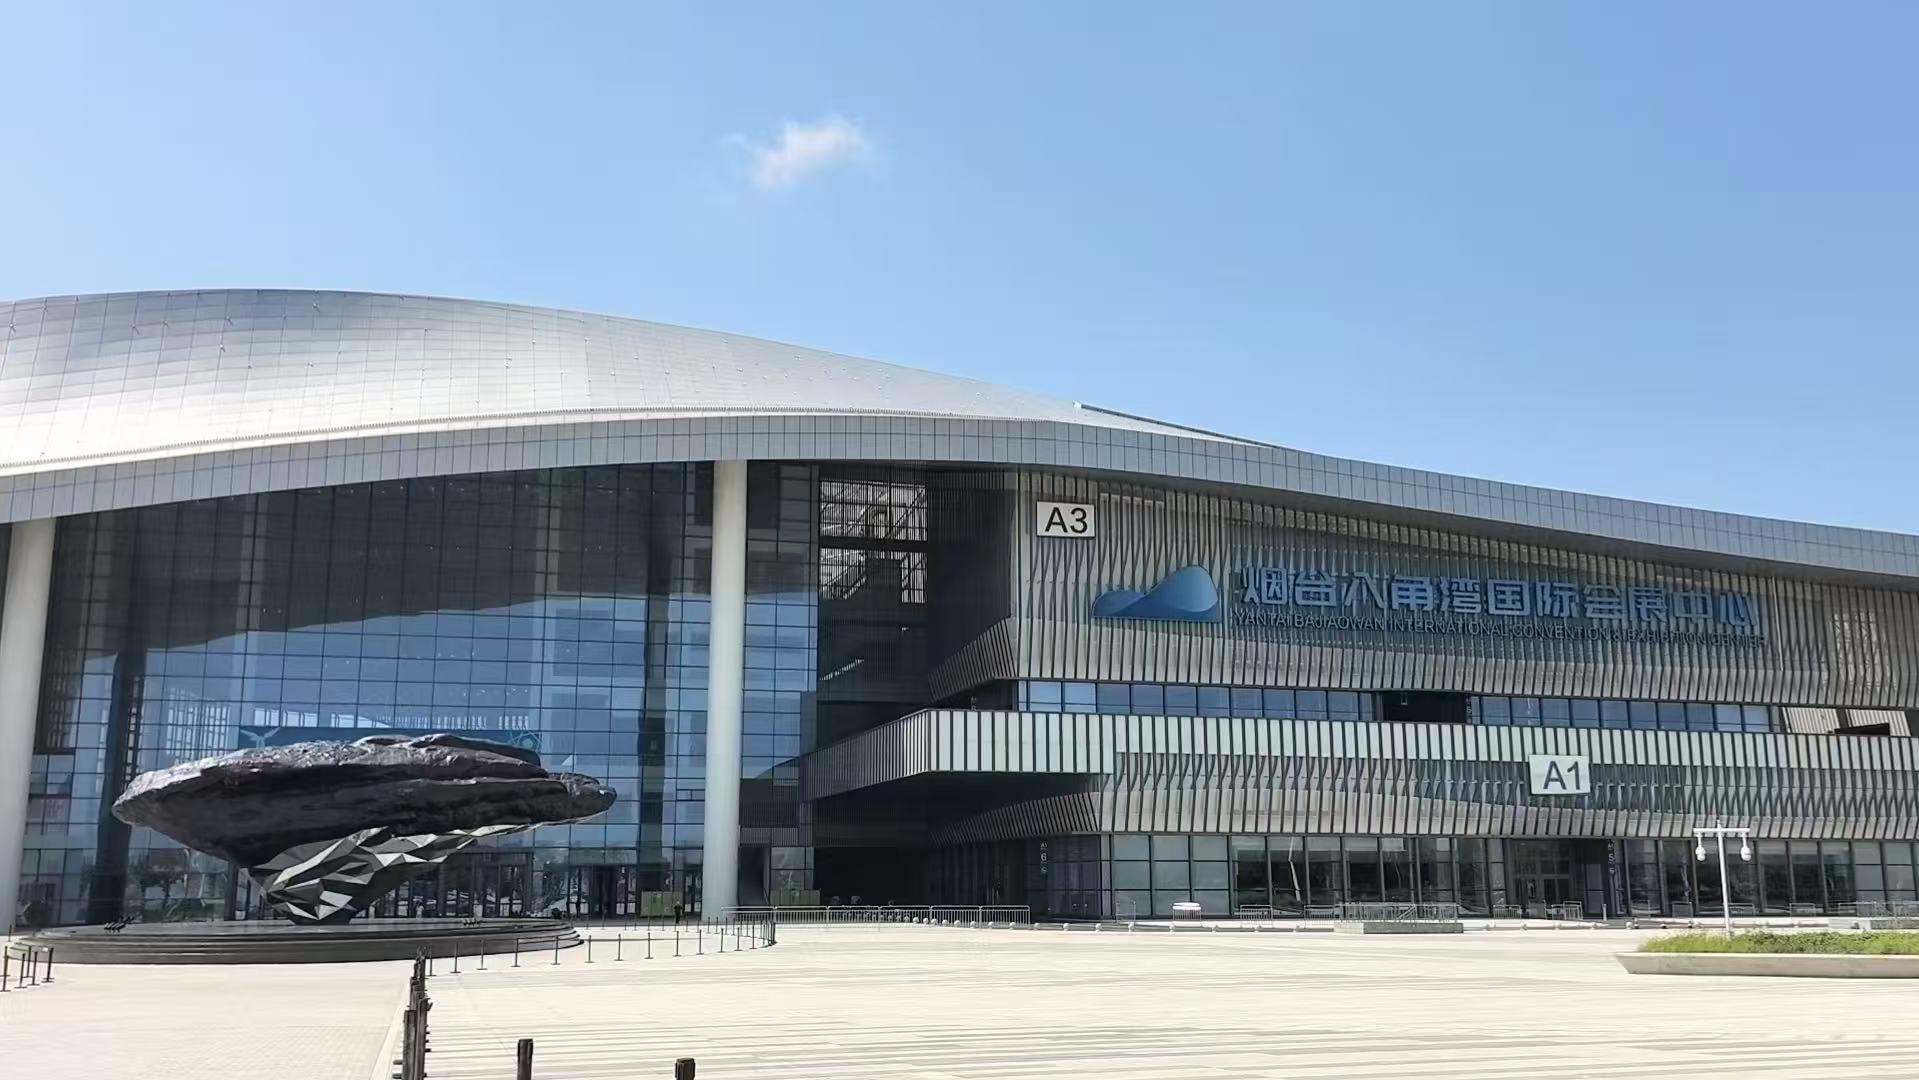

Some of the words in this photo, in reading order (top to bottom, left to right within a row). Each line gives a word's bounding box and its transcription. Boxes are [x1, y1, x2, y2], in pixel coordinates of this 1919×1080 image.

[1044, 506, 1089, 534] A3
[1241, 566, 1759, 628] 烟台八角湾国际会展中心
[1234, 611, 1290, 627] YANTAI
[1294, 615, 1384, 632] BAJIAOWAN
[1390, 617, 1510, 637] INTERNATIONAL
[1512, 624, 1610, 642] CONVENTION
[1543, 761, 1581, 790] A1
